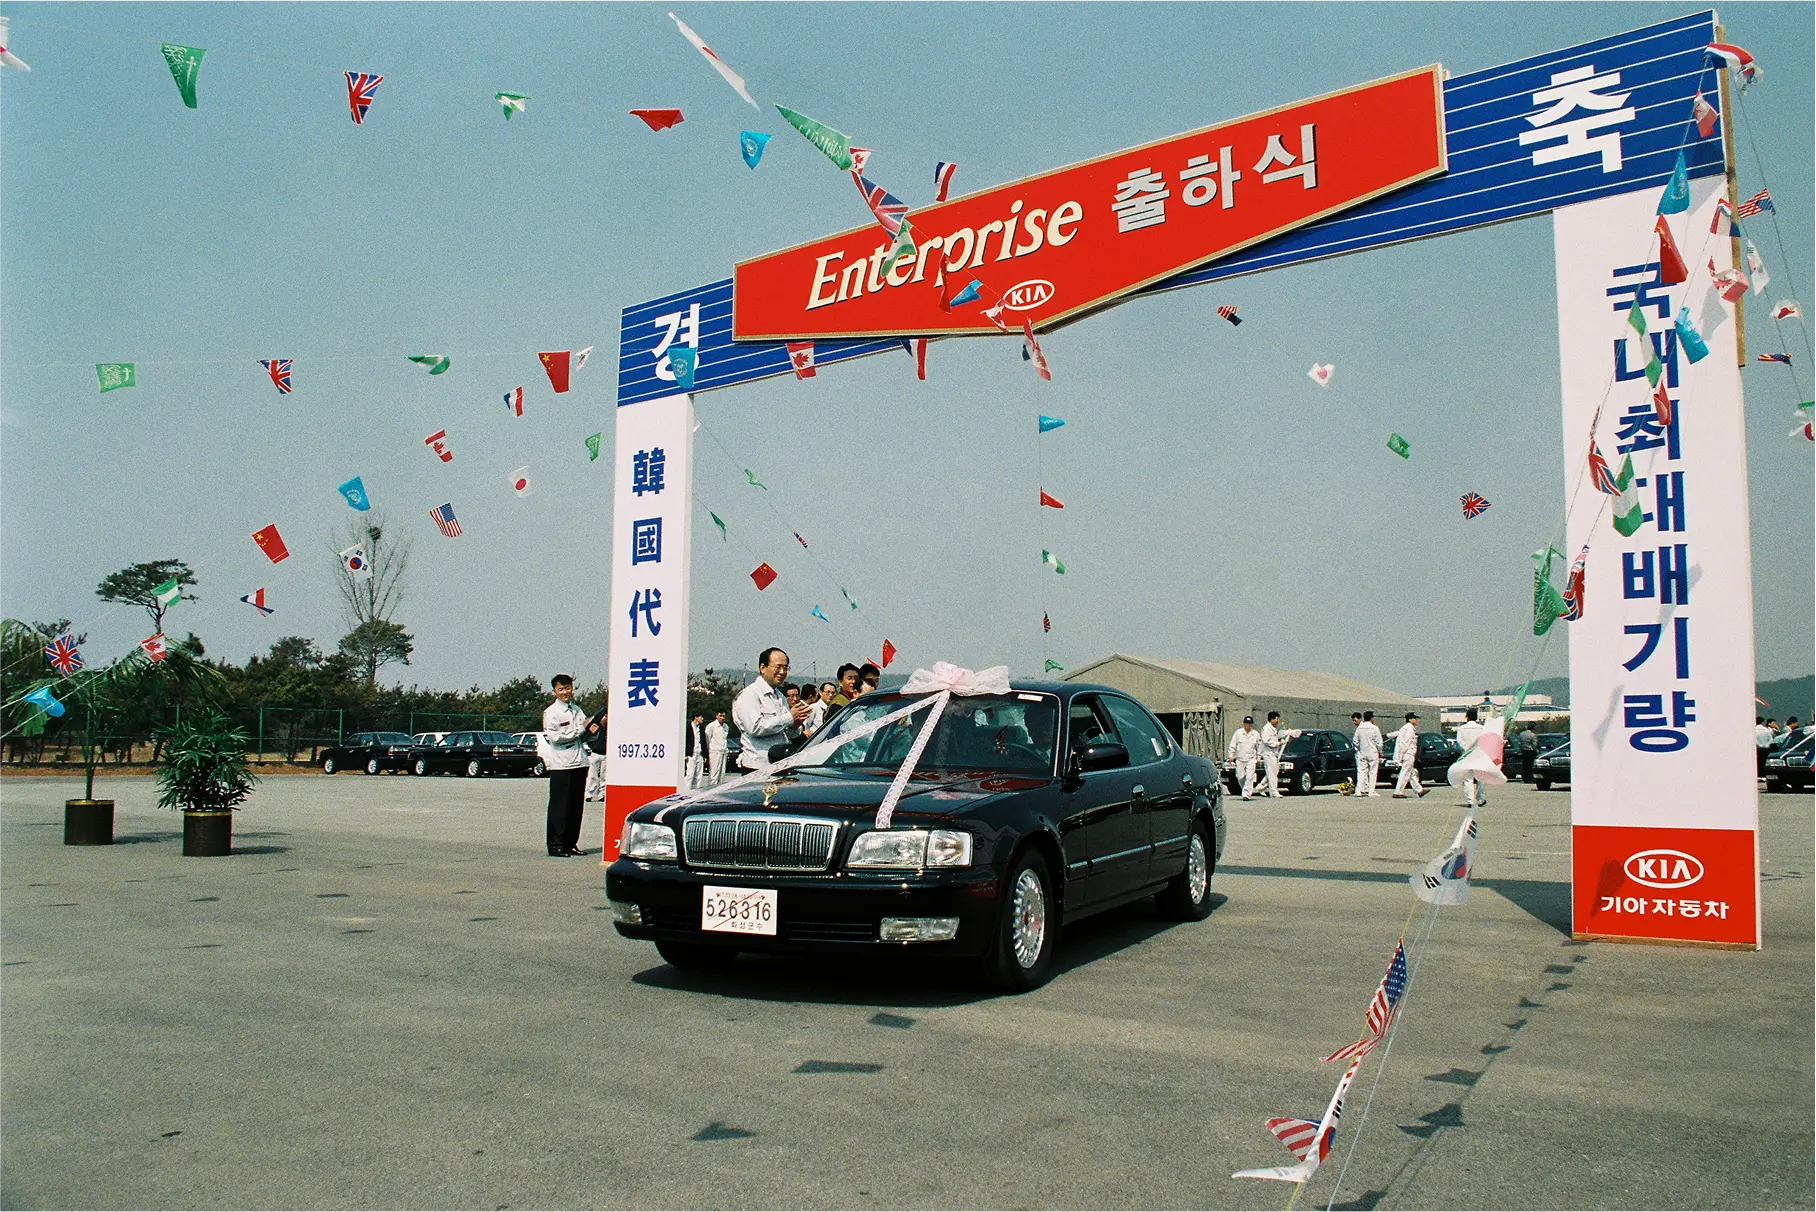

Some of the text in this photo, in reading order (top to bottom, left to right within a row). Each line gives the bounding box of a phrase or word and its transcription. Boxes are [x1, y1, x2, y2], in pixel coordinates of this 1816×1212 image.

[1519, 64, 1636, 173] 축
[805, 123, 1318, 310] Enterprise 출하식
[1012, 285, 1046, 305] KIA
[652, 303, 700, 381] 경
[627, 447, 665, 708] 韓國代表
[618, 744, 665, 758] 1997.3.28
[1638, 858, 1692, 880] KIA
[706, 898, 771, 921] 526316
